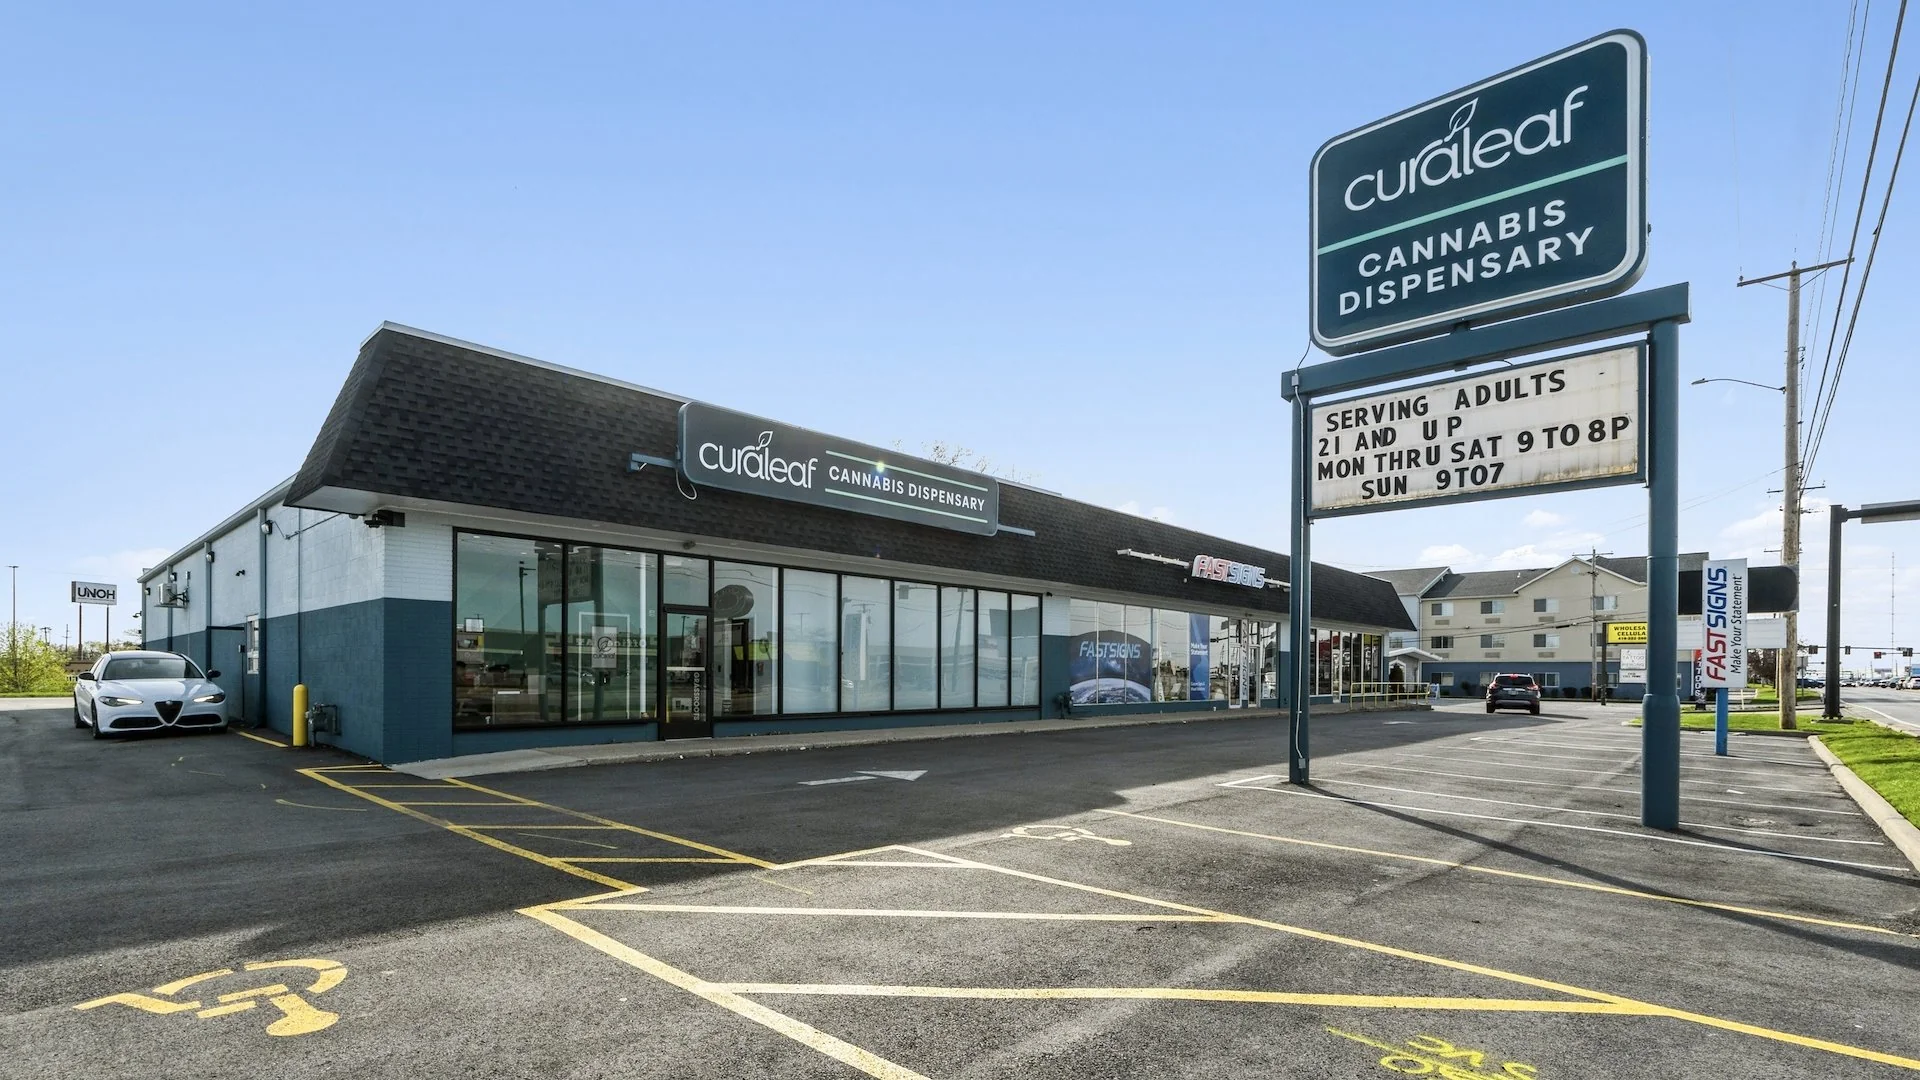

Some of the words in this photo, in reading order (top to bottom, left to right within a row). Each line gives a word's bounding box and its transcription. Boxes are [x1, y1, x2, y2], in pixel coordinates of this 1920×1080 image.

[1344, 84, 1589, 212] curaleaf
[1358, 199, 1567, 278] CANNABIS
[1339, 226, 1595, 316] DISPENSARY
[1326, 395, 1429, 433] SERVING
[1454, 369, 1566, 411] ADULTS
[1317, 456, 1366, 481] MON
[1374, 445, 1441, 473] THRU
[1451, 435, 1503, 463] SAT
[1517, 431, 1535, 453] 9
[1542, 424, 1580, 448] TO
[1355, 427, 1397, 451] AND
[699, 436, 818, 489] curaleaf
[828, 465, 905, 495] CANNABIS
[908, 483, 985, 512] DISPENSARY
[1362, 475, 1408, 500] SUN
[78, 586, 115, 599] UNOH
[1192, 555, 1266, 589] FASTSIGNS
[1707, 567, 1728, 681] FASTSIGNS
[1731, 575, 1743, 625] Statement
[1079, 641, 1141, 658] FASTSIGNS
[1730, 626, 1742, 648] Your
[1730, 650, 1742, 674] Make
